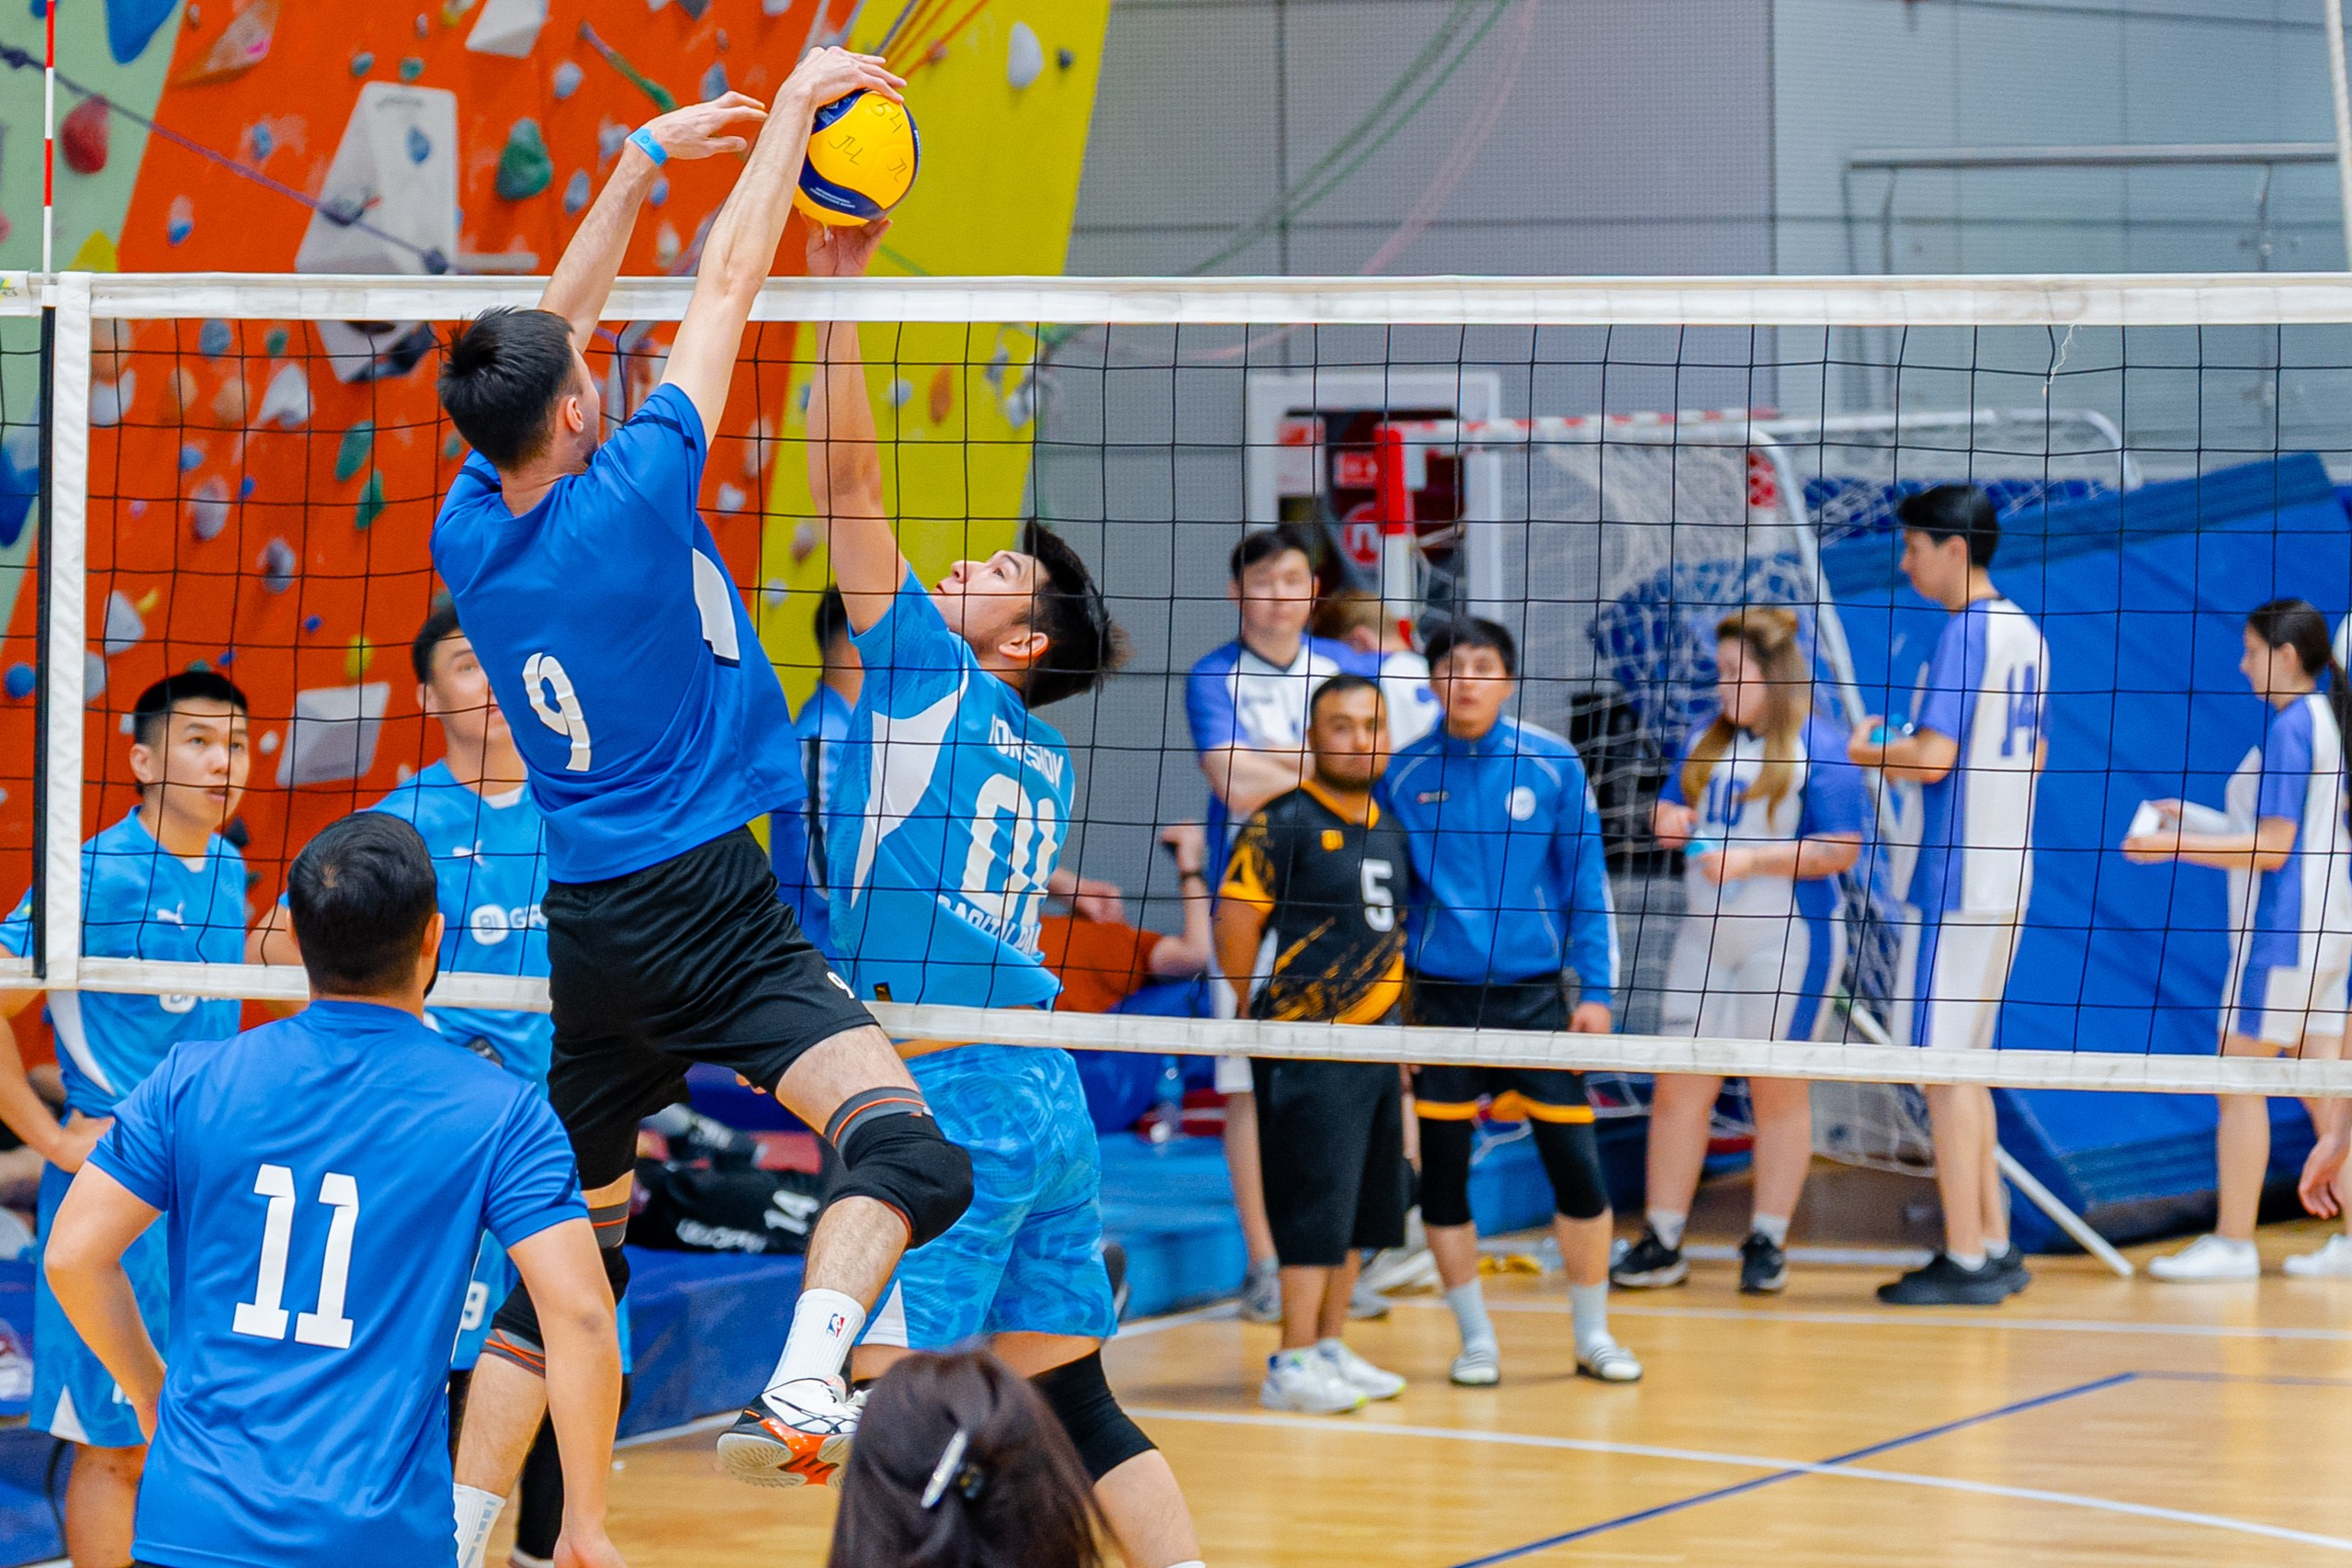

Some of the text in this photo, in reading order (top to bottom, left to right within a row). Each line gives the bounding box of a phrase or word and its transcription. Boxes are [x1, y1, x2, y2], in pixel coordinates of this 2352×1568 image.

[522, 651, 592, 773] 9
[1360, 857, 1396, 932] 5
[826, 971, 856, 999] 9
[763, 1190, 821, 1235] 14
[232, 1163, 360, 1350] 11
